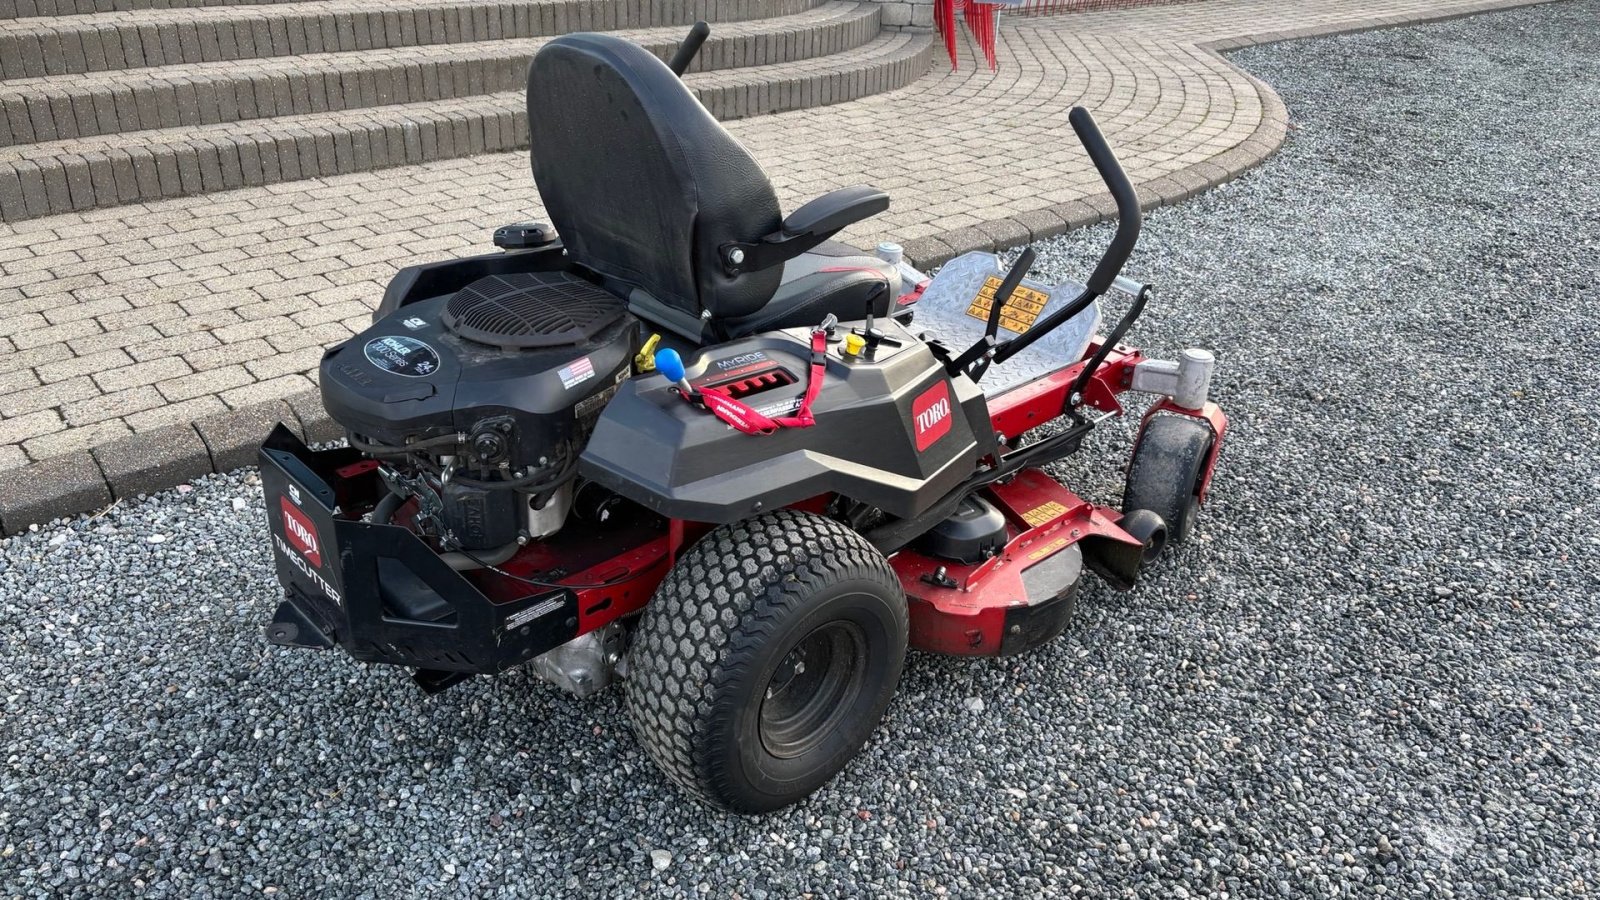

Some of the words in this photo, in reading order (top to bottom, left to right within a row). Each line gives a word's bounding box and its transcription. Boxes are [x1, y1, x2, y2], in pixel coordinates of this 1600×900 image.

[380, 337, 411, 356] KOHLER
[385, 350, 408, 367] Series
[916, 397, 948, 435] TORO
[284, 510, 318, 554] TORO
[273, 533, 341, 606] TIMECUTTER
